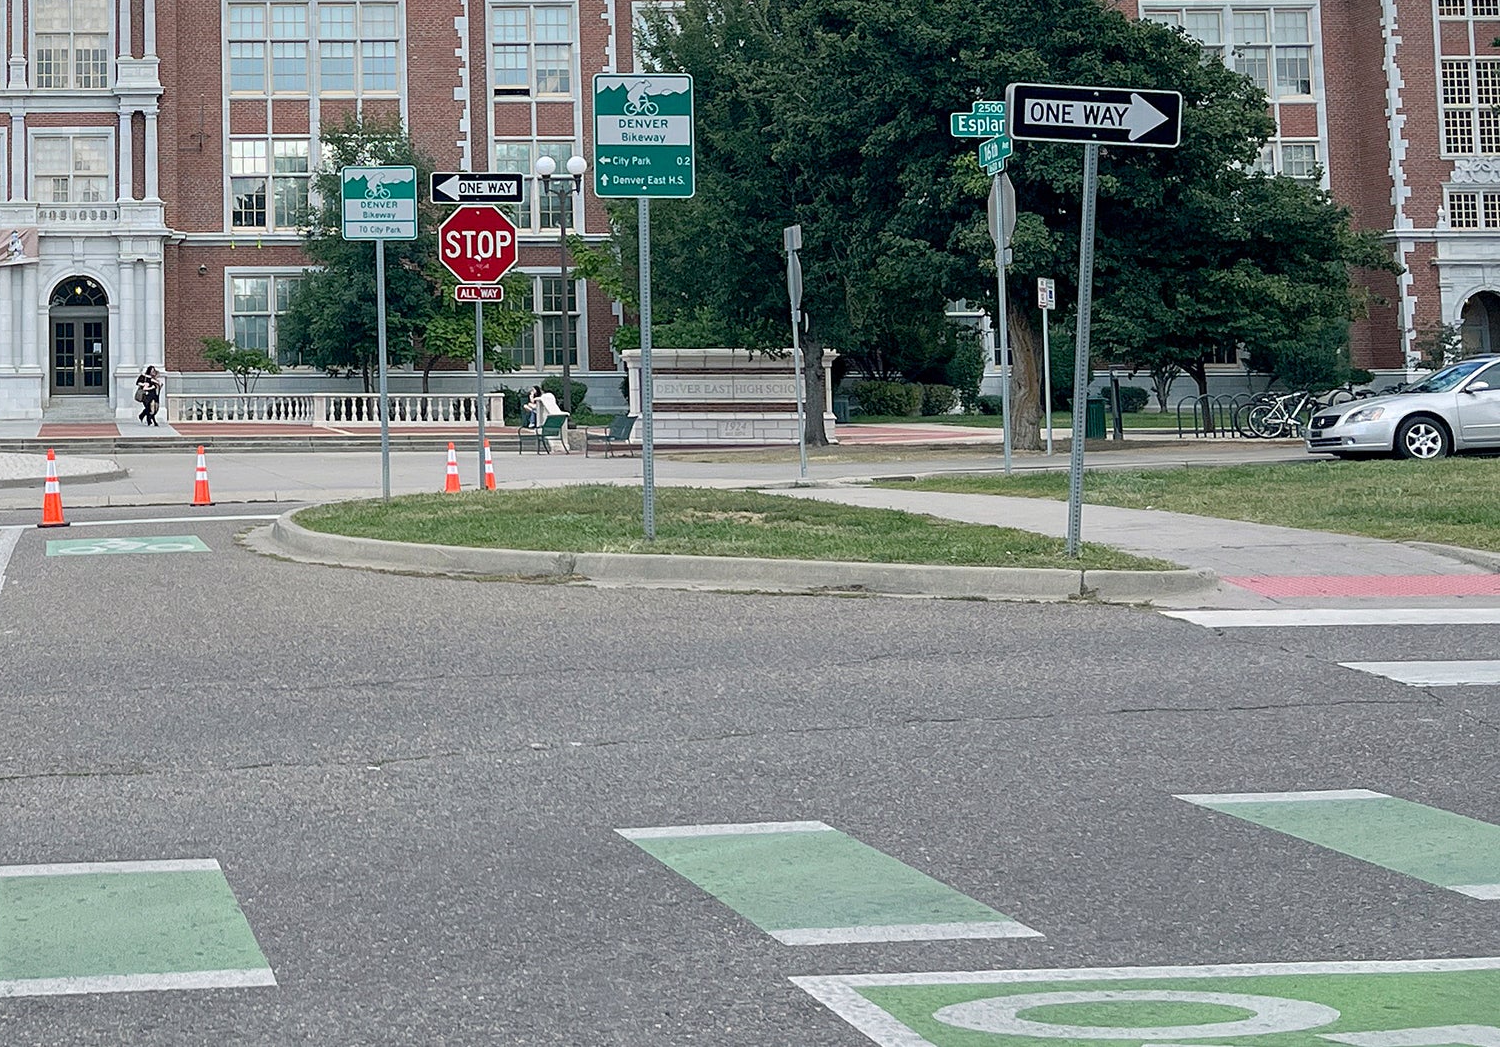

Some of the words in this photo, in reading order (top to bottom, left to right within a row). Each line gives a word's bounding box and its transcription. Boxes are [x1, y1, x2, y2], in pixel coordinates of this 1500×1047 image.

[978, 104, 1003, 113] 2500
[1030, 102, 1074, 124] ONE
[1083, 104, 1129, 126] WAY
[618, 119, 668, 129] DENVER
[621, 132, 666, 143] Bikeway
[612, 156, 629, 167] City
[632, 156, 652, 165] Park
[676, 156, 691, 166] 0.2
[612, 175, 645, 185] Denver
[647, 175, 666, 185] East
[459, 182, 484, 194] ONE
[487, 182, 513, 194] WAY
[360, 200, 398, 209] DENVER
[362, 211, 396, 220] Bikeway
[369, 225, 384, 235] City
[385, 225, 401, 234] Park
[445, 230, 512, 259] STOP
[460, 288, 479, 299] ALL
[480, 288, 499, 299] WAY
[655, 384, 701, 395] DENVER
[704, 384, 732, 395] EAST
[735, 384, 764, 395] HIGH
[724, 421, 747, 431] 1924
